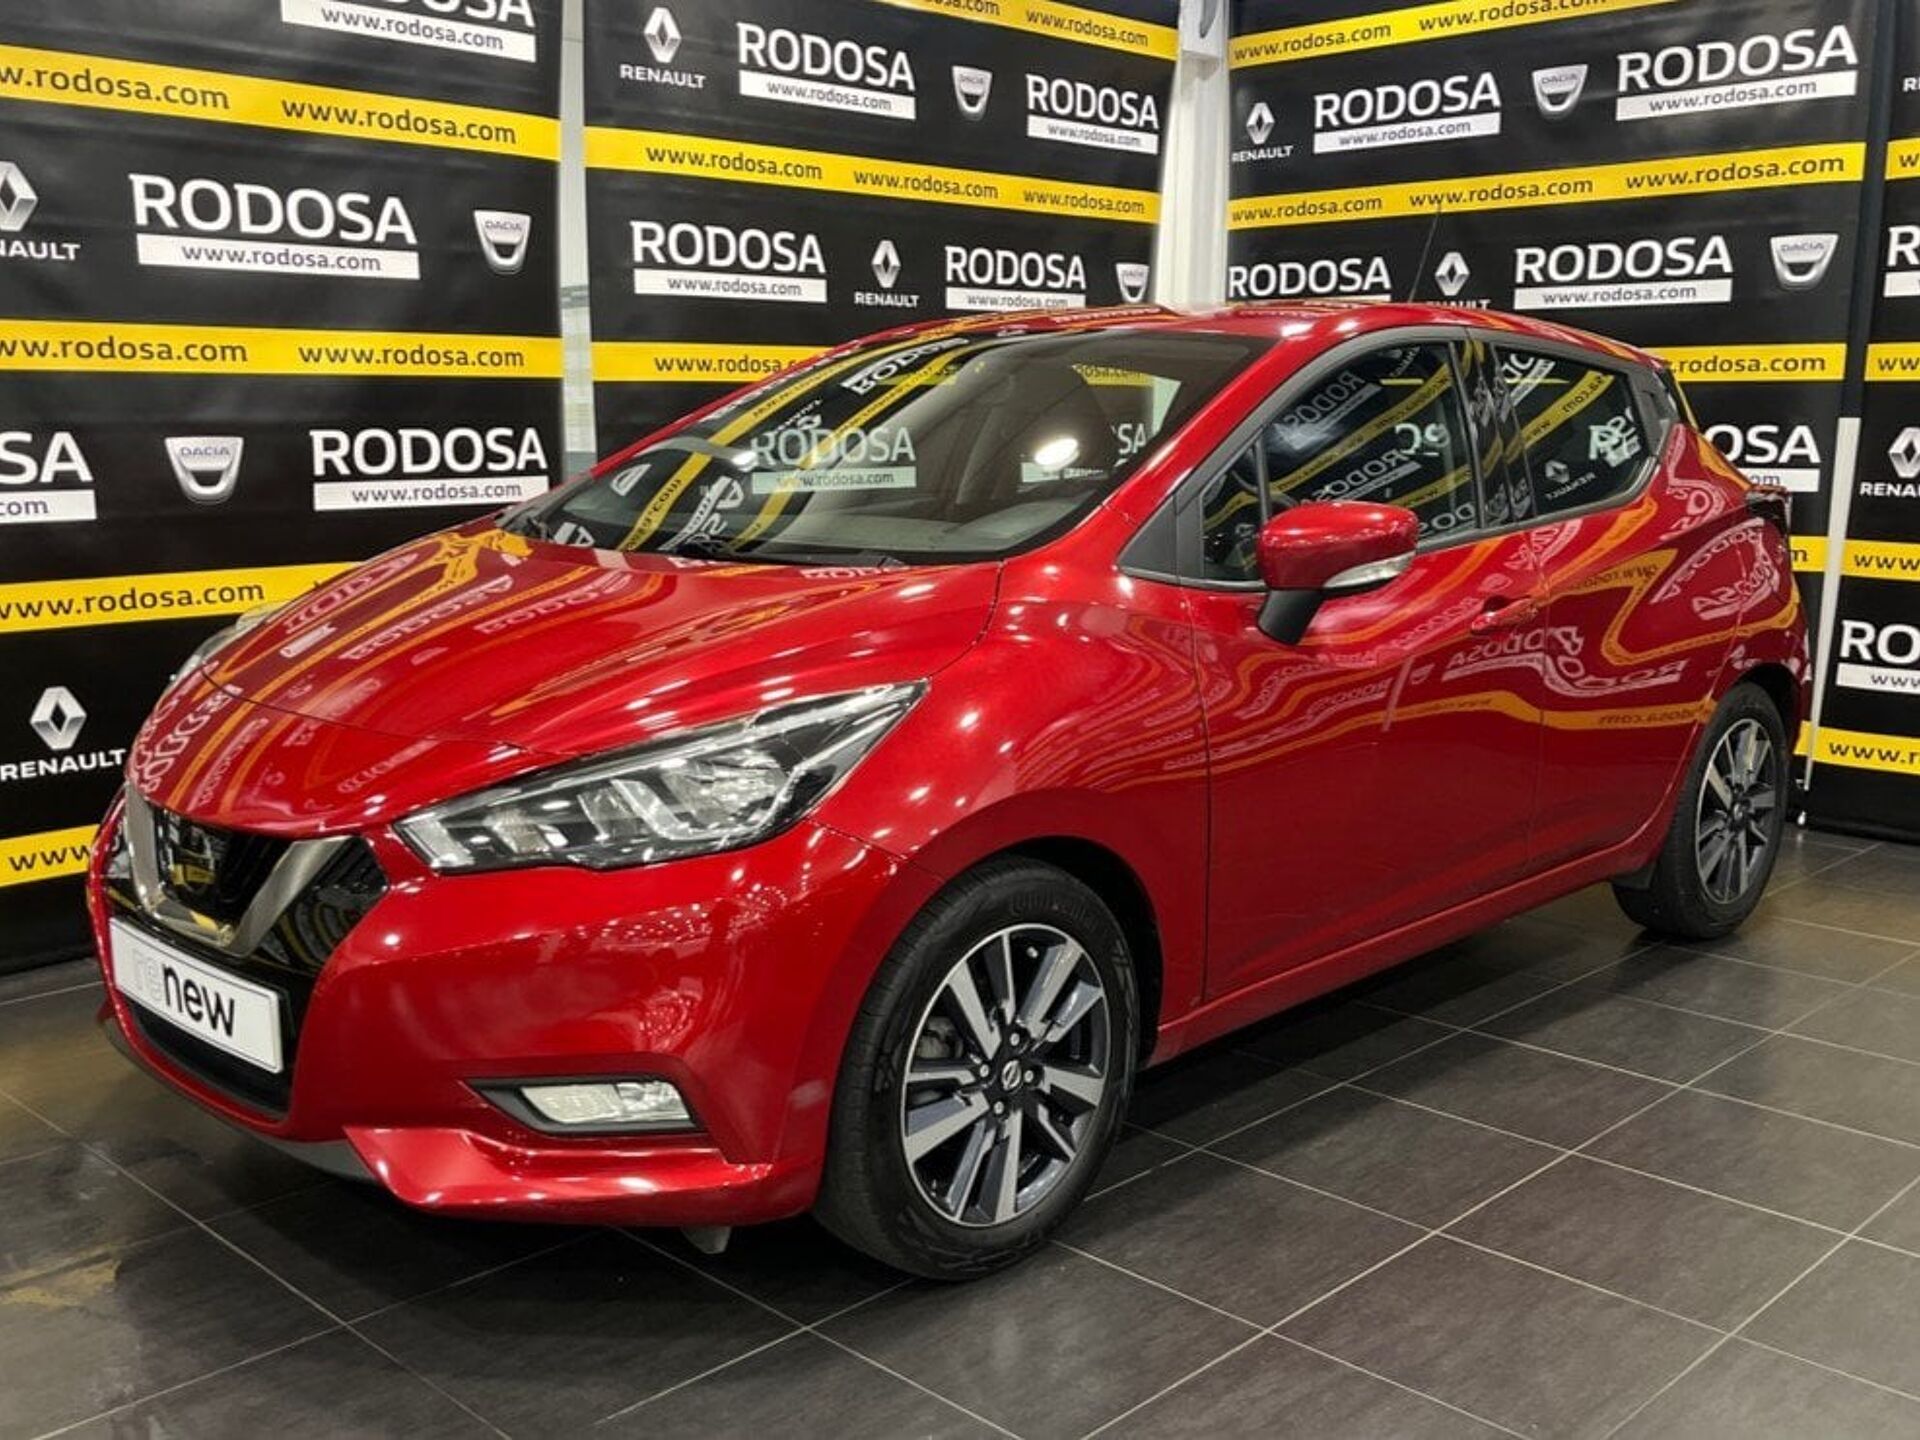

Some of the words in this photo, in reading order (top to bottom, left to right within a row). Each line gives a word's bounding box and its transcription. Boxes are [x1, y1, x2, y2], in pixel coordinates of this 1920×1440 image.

[321, 7, 504, 50] www.rodosa.com
[1026, 8, 1149, 47] www.rodosa.com
[1235, 24, 1391, 61] www.rodosa.com
[736, 21, 916, 92] RODOSA
[1616, 25, 1858, 92] RODOSA
[620, 64, 706, 89] RENAULT
[767, 79, 892, 112] www.rodosa.com
[1025, 73, 1160, 129] RODOSA
[1314, 71, 1501, 129] RODOSA
[1649, 81, 1818, 115] www.rodosa.com
[282, 99, 517, 144] www.rodosa.com
[1046, 121, 1142, 148] www.rodosa.com
[1339, 120, 1471, 148] www.rodosa.com
[646, 143, 823, 180] www.rodosa.com
[1231, 144, 1293, 163] RENAULT
[854, 167, 998, 200] www.rodosa.com
[1625, 154, 1845, 190] www.rodosa.com
[1023, 187, 1145, 214] www.rodosa.com
[1232, 193, 1383, 224] www.rodosa.com
[1409, 176, 1594, 208] www.rodosa.com
[128, 173, 417, 246] RODOSA
[182, 244, 381, 272] www.rodosa.com
[630, 220, 827, 275] RODOSA
[1514, 236, 1733, 284] RODOSA
[945, 246, 1087, 290] RODOSA
[1228, 256, 1392, 298] RODOSA
[668, 274, 802, 298] www.rodosa.com
[853, 291, 920, 309] RENAULT
[1543, 285, 1696, 306] www.rodosa.com
[298, 343, 524, 368] www.rodosa.com
[180, 447, 231, 456] DACIA
[310, 427, 548, 477] RODOSA
[352, 481, 522, 503] www.rodosa.com
[0, 749, 126, 782] RENAULT
